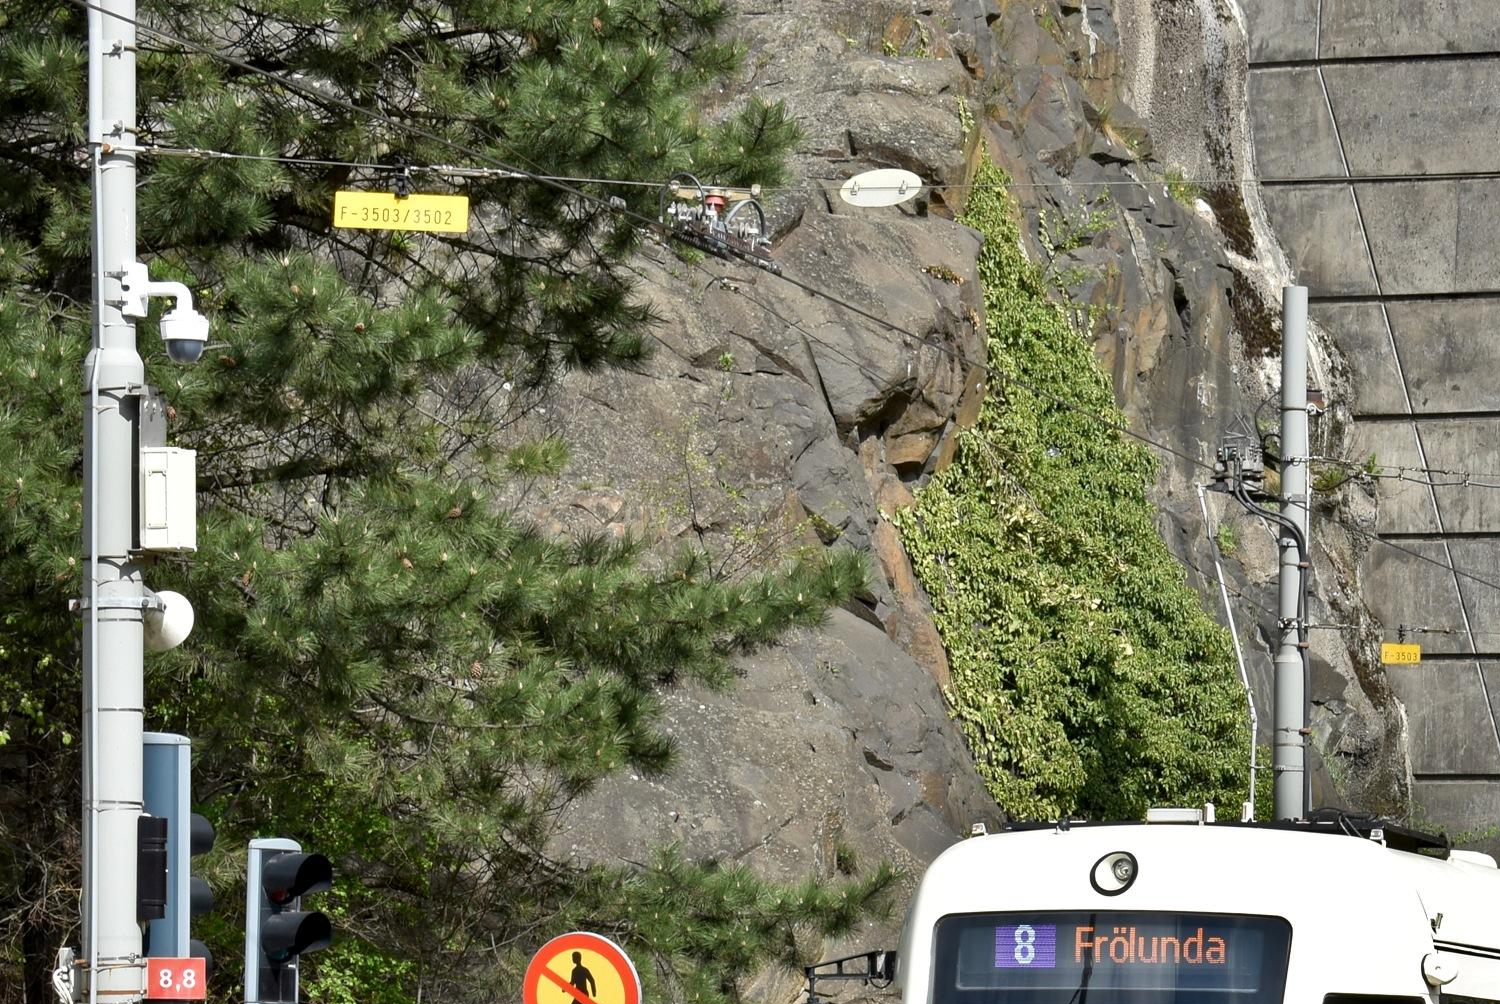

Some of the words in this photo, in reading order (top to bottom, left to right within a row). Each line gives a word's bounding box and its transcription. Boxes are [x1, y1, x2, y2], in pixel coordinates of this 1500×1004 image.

[340, 206, 452, 225] F-3503/3502
[1384, 651, 1418, 661] F-3503
[1014, 924, 1036, 964] 8
[1074, 926, 1226, 964] Frölunda
[159, 968, 196, 993] 8,8
